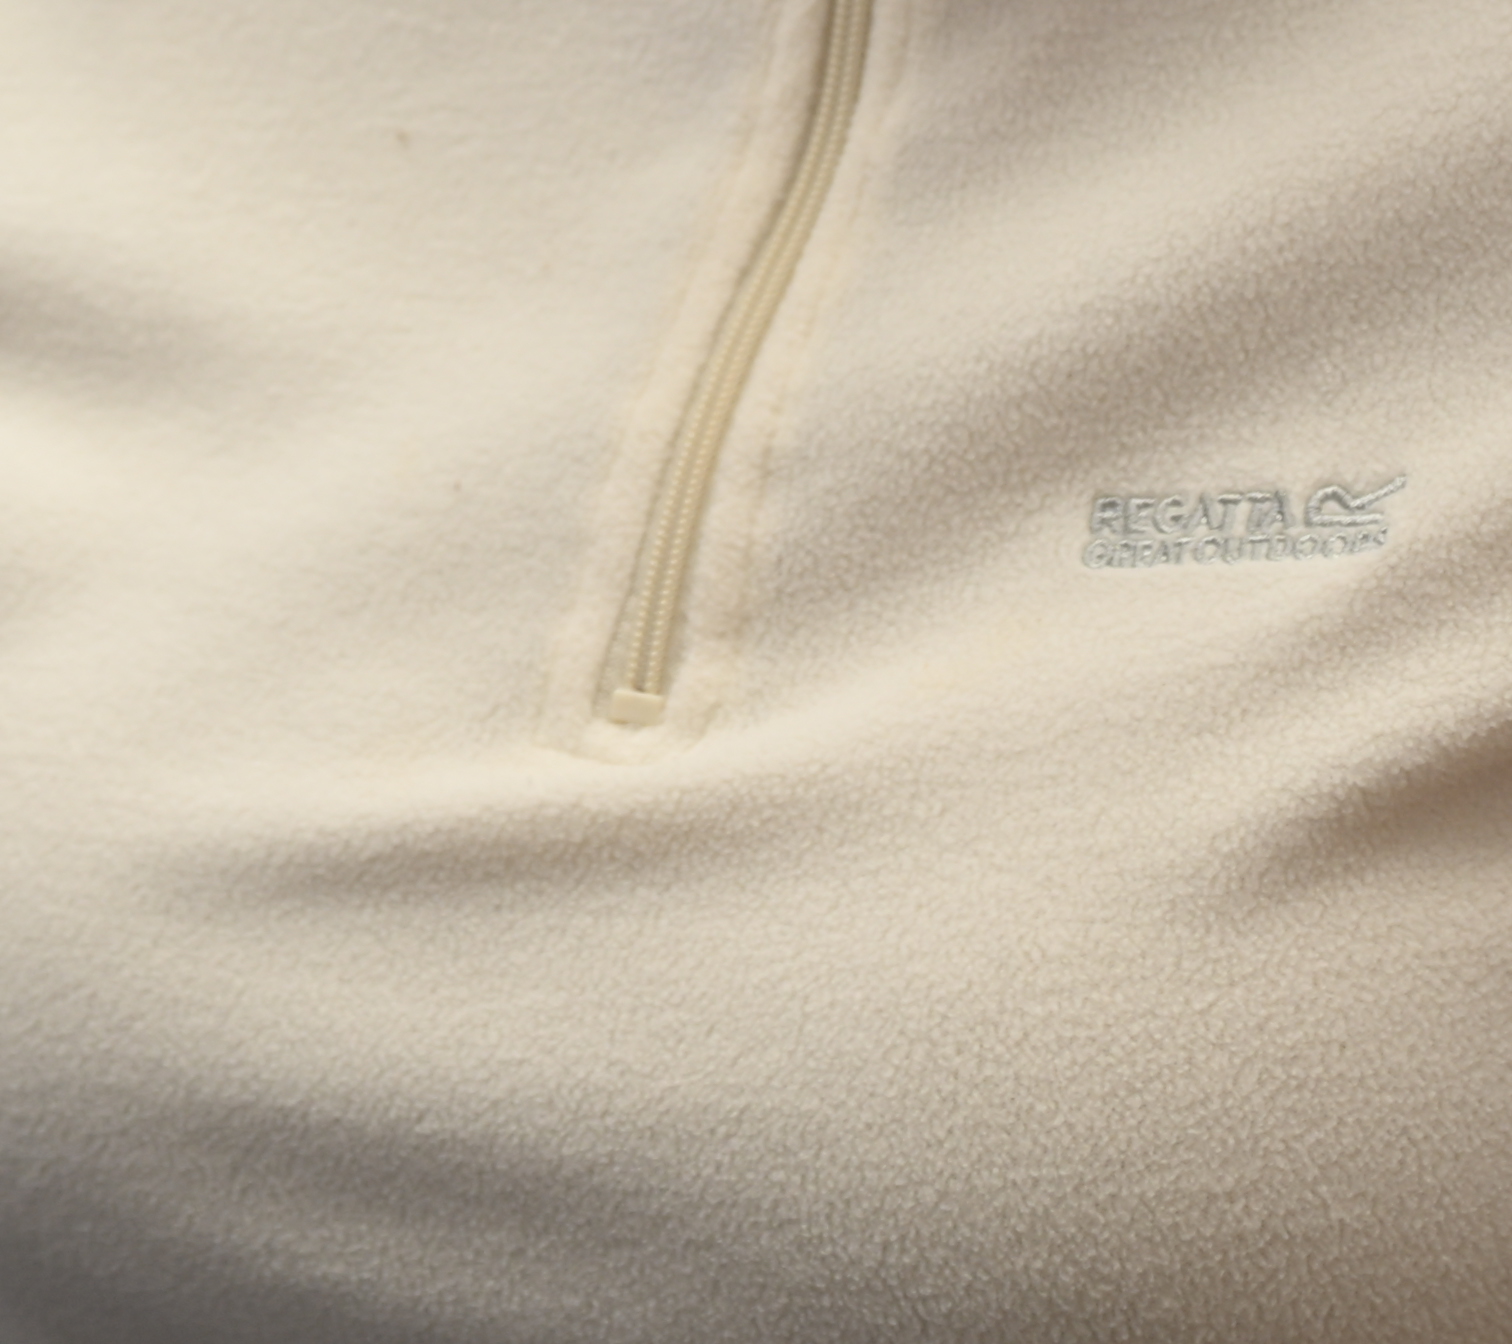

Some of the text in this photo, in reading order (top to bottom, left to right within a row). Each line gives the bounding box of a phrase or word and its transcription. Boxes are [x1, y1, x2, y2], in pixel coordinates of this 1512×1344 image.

[1091, 490, 1293, 534] REGATTA
[1083, 527, 1389, 568] GREAT OUTDOORS
